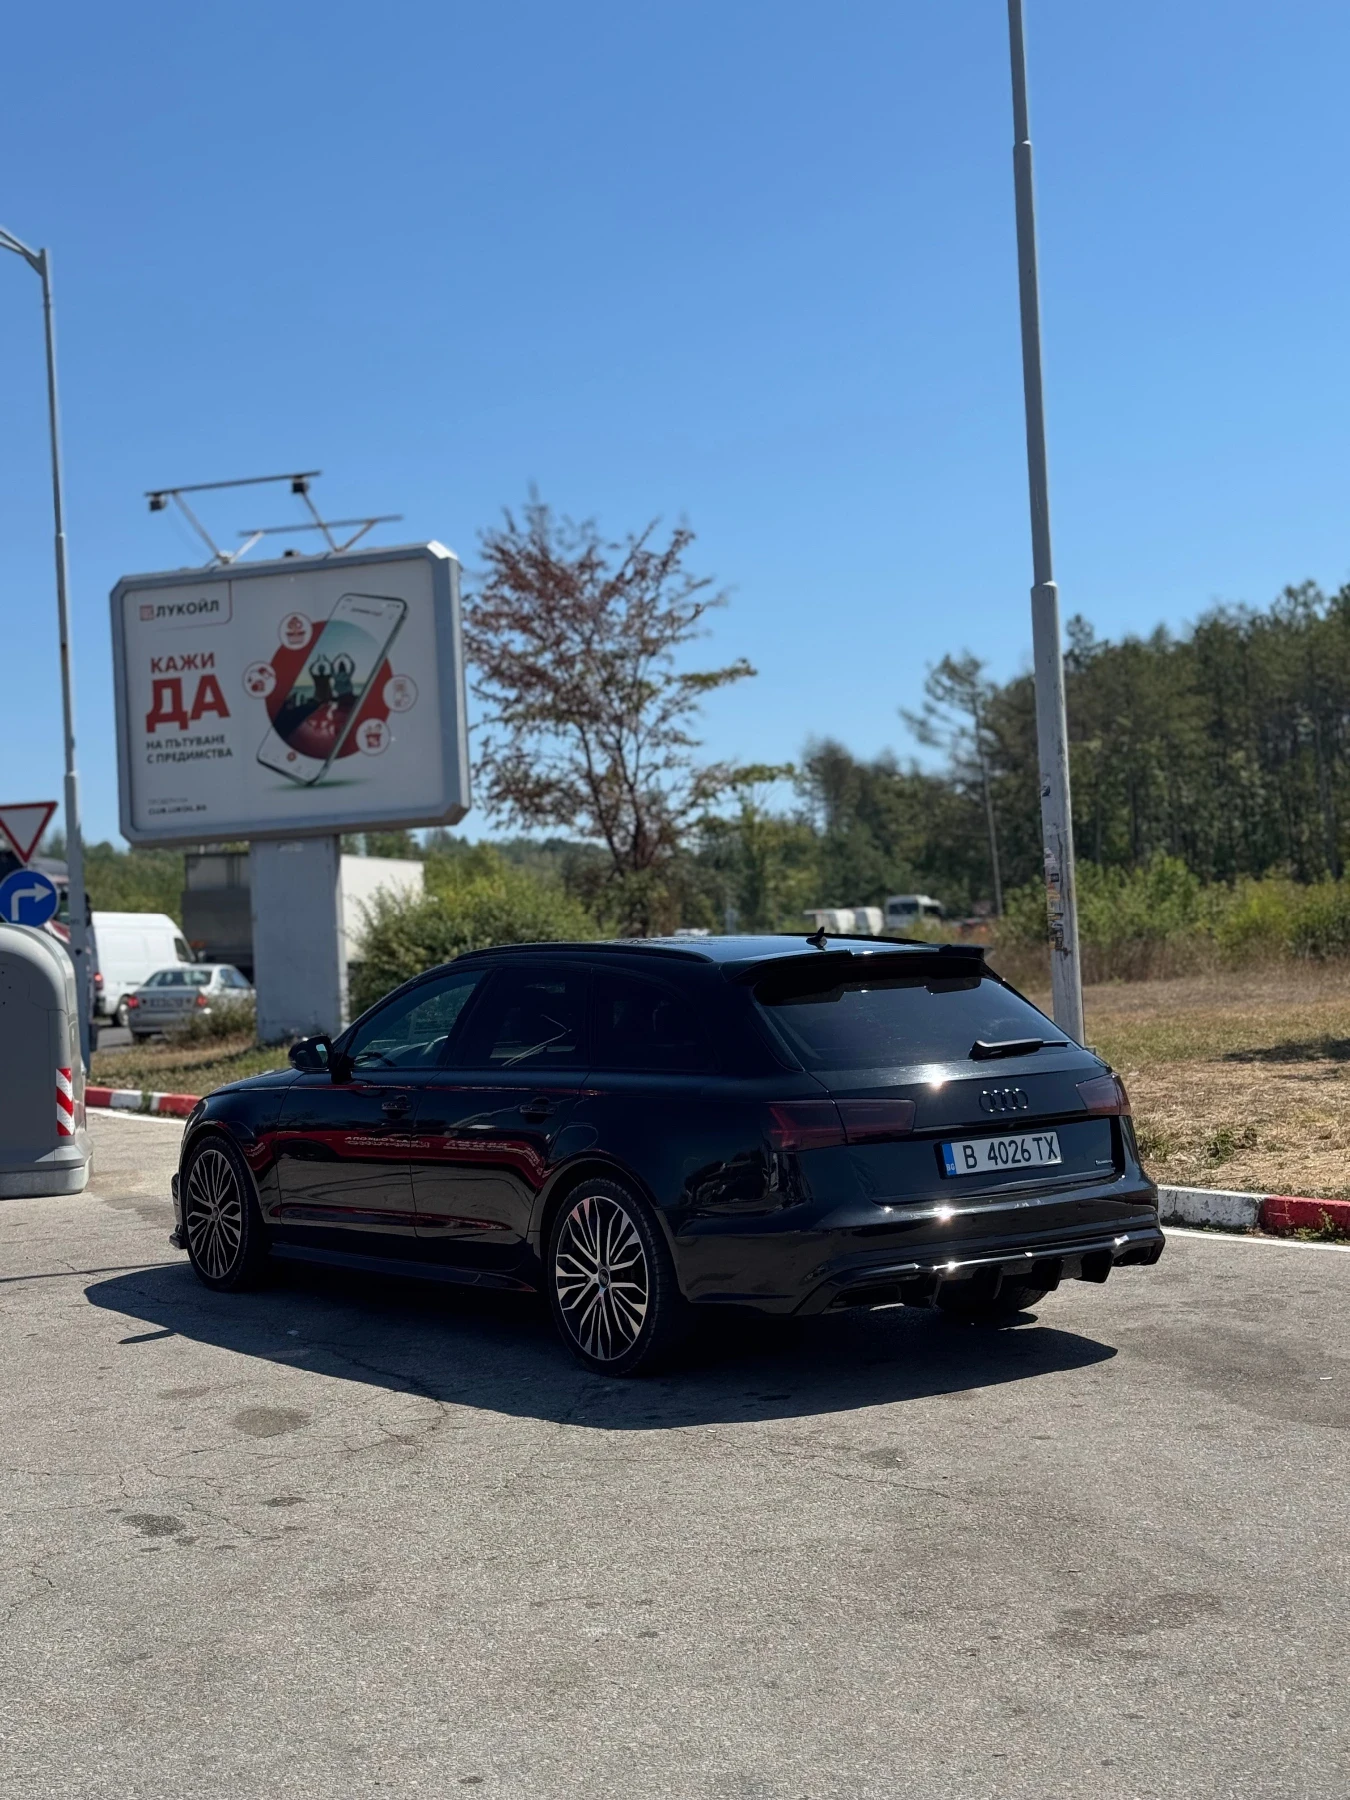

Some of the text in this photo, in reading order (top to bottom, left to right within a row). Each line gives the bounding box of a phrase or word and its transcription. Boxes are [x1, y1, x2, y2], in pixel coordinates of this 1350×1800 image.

[156, 598, 219, 618] ЛУКОЙЛ
[151, 651, 216, 674] КАЖИ
[145, 673, 231, 733] ДА
[146, 734, 225, 751] НА ПЪТУВАНЕ
[147, 747, 233, 764] С ПРЕДИМСТВА
[962, 1135, 1058, 1170] B 4026 TX
[946, 1163, 956, 1172] BG
